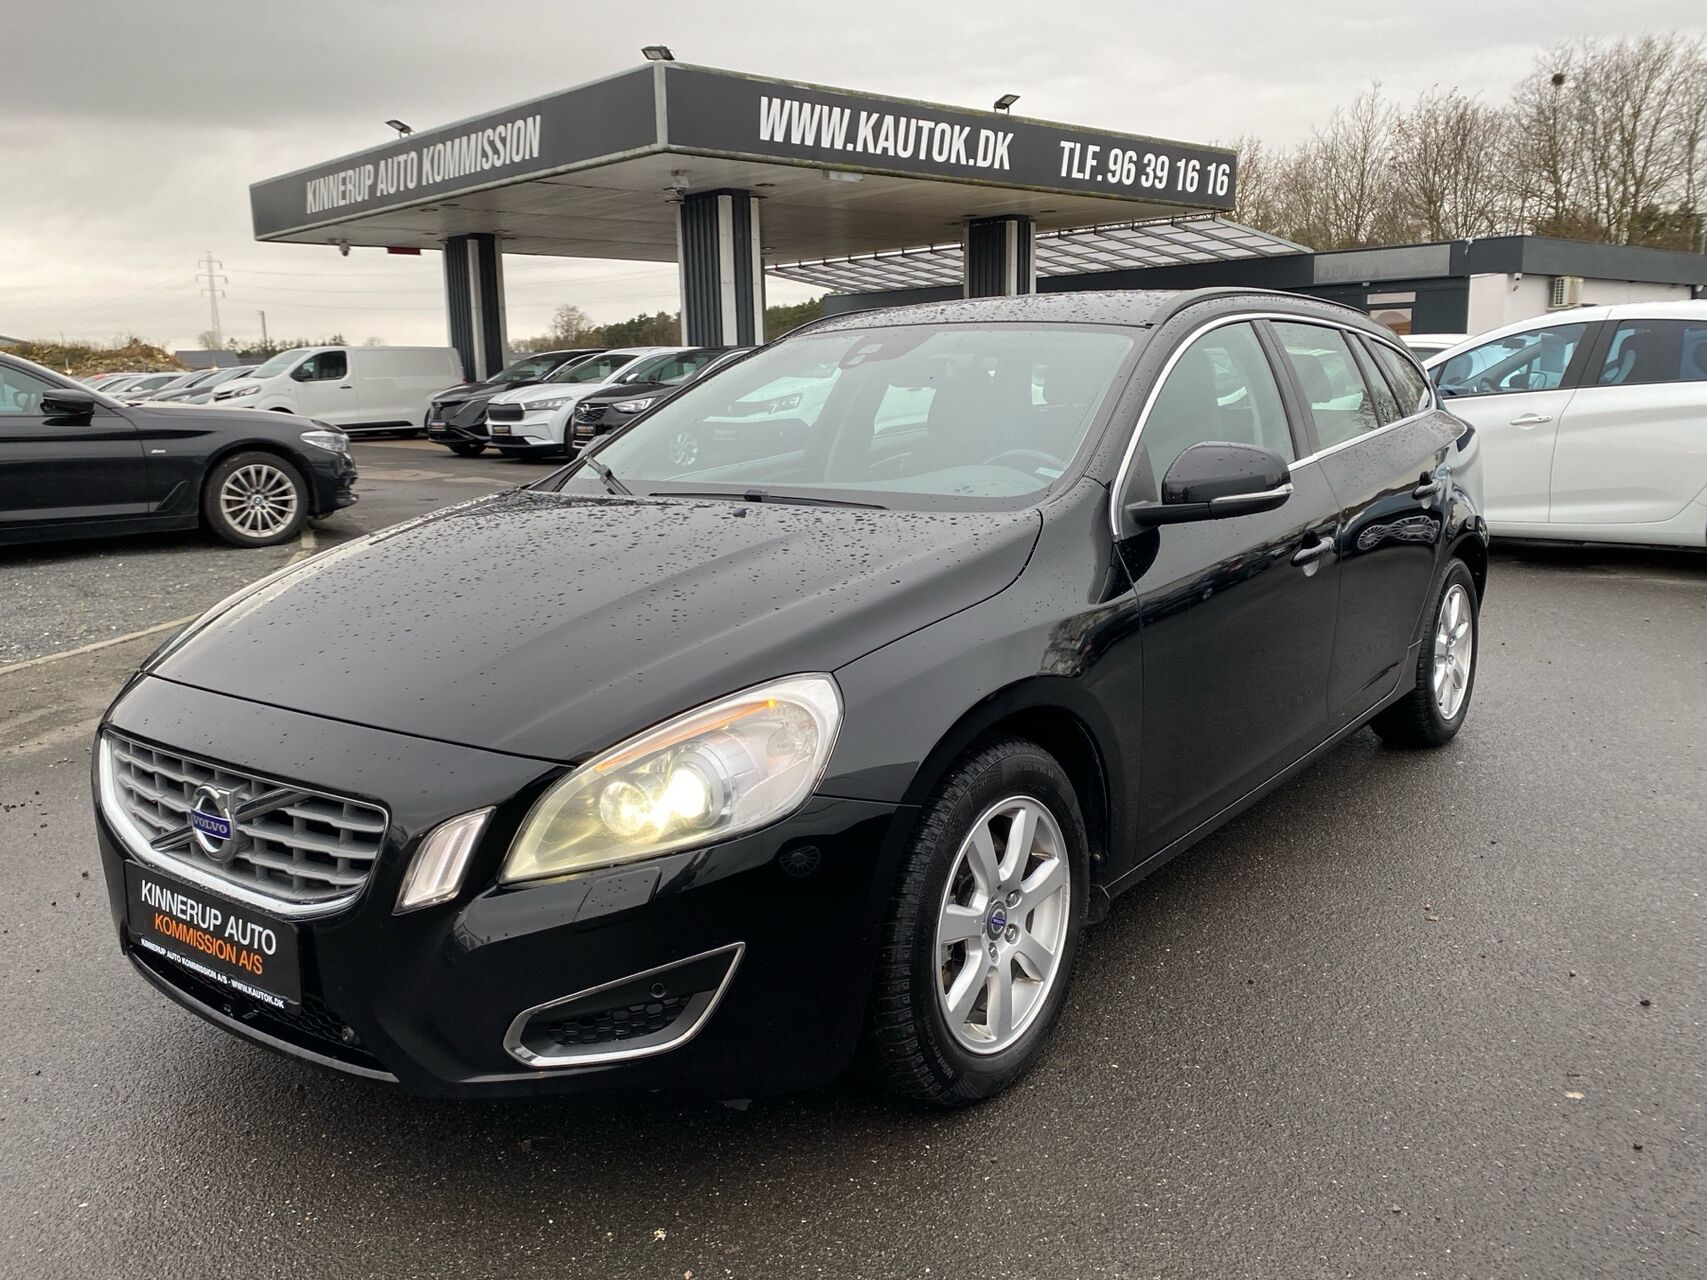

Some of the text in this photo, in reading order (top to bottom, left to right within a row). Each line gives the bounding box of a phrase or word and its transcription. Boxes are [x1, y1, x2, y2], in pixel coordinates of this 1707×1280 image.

[306, 115, 541, 214] KINNERUP AUTO KOMMISSION
[759, 96, 1014, 170] WWW.KAUTOK.DK
[1060, 140, 1230, 196] TLF. 96 39 16 16
[192, 814, 228, 834] VOLVO
[141, 880, 276, 955] KINNERUP AUTO
[154, 913, 263, 975] KOMMISSION A/S
[140, 937, 166, 955] KINNERUP
[166, 950, 181, 963] AUTO
[181, 954, 217, 980] KOMMISSION
[231, 979, 285, 1009] WWW.KAUTOK.DK
